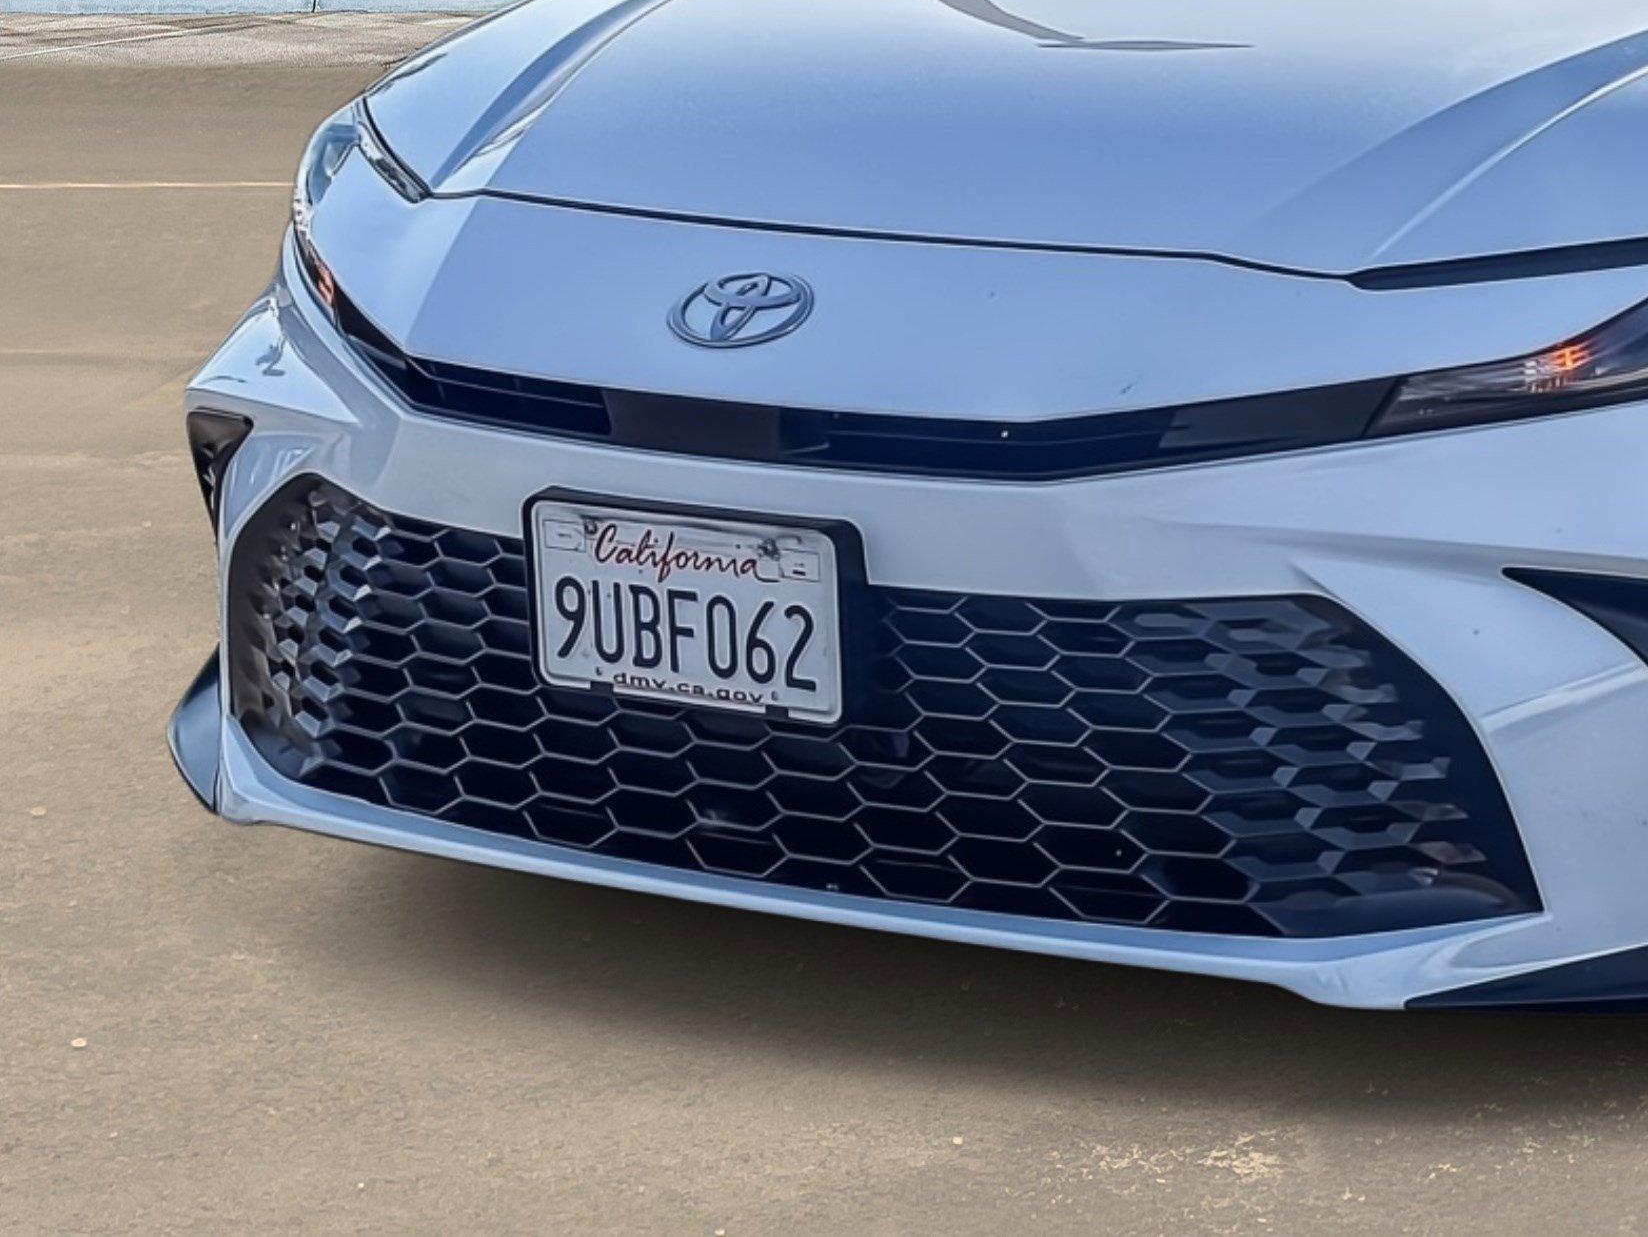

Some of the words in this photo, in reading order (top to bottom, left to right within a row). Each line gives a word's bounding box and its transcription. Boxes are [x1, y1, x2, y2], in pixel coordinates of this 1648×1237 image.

[594, 523, 779, 583] California
[555, 576, 816, 692] 9UBF062
[613, 672, 764, 704] dmv.ca.gov
